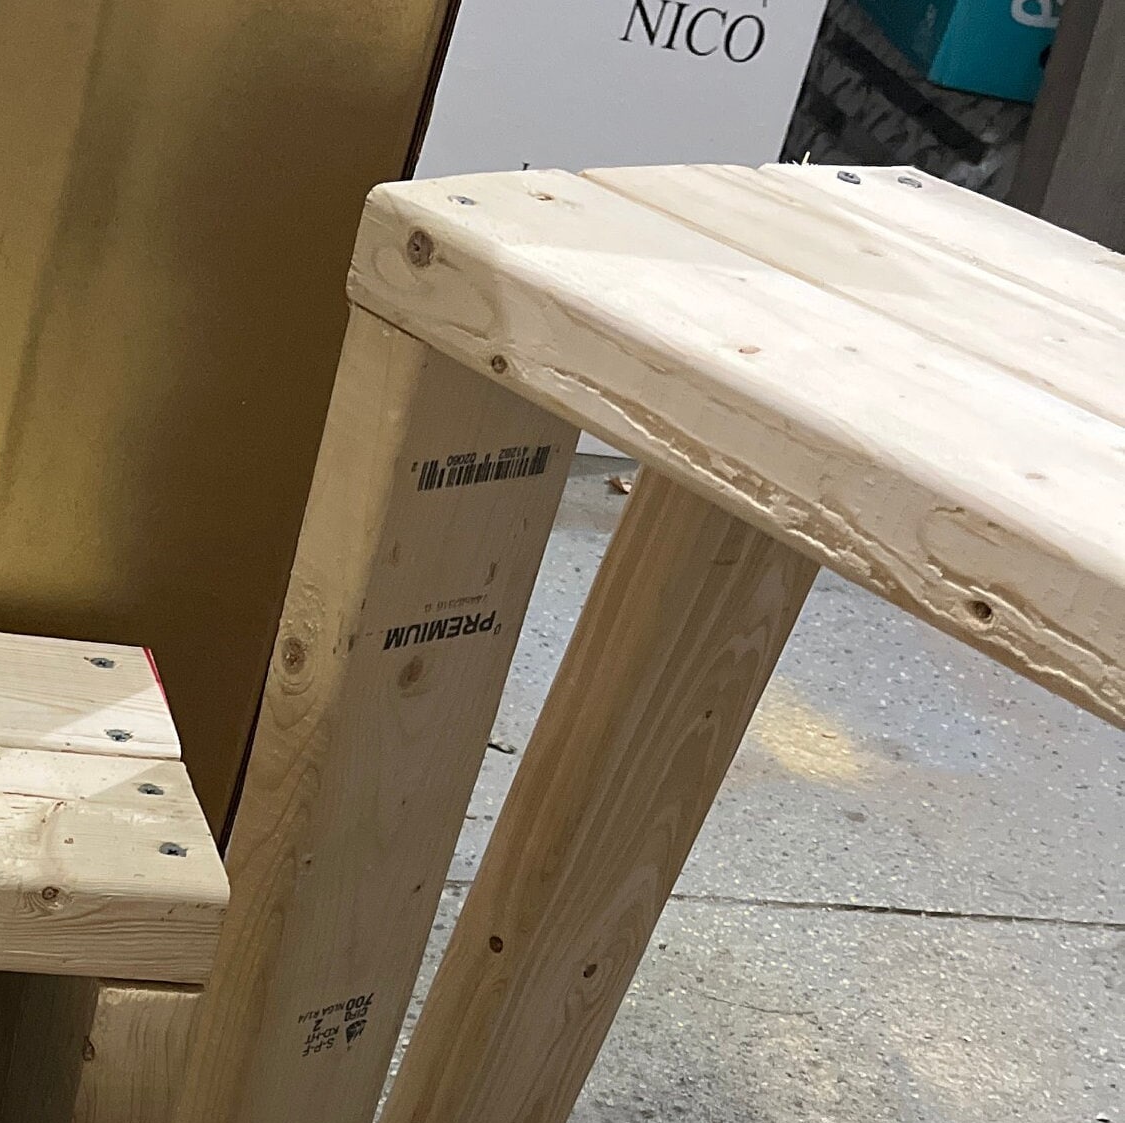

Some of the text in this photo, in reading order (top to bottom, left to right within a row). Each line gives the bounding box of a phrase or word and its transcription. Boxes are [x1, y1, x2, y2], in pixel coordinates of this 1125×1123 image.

[619, 0, 765, 63] NICO
[383, 610, 497, 650] PREMIUM
[345, 992, 374, 1011] 700
[313, 1018, 323, 1032] 2
[304, 1026, 339, 1045] KD-HT
[302, 1037, 335, 1057] S-P-F
